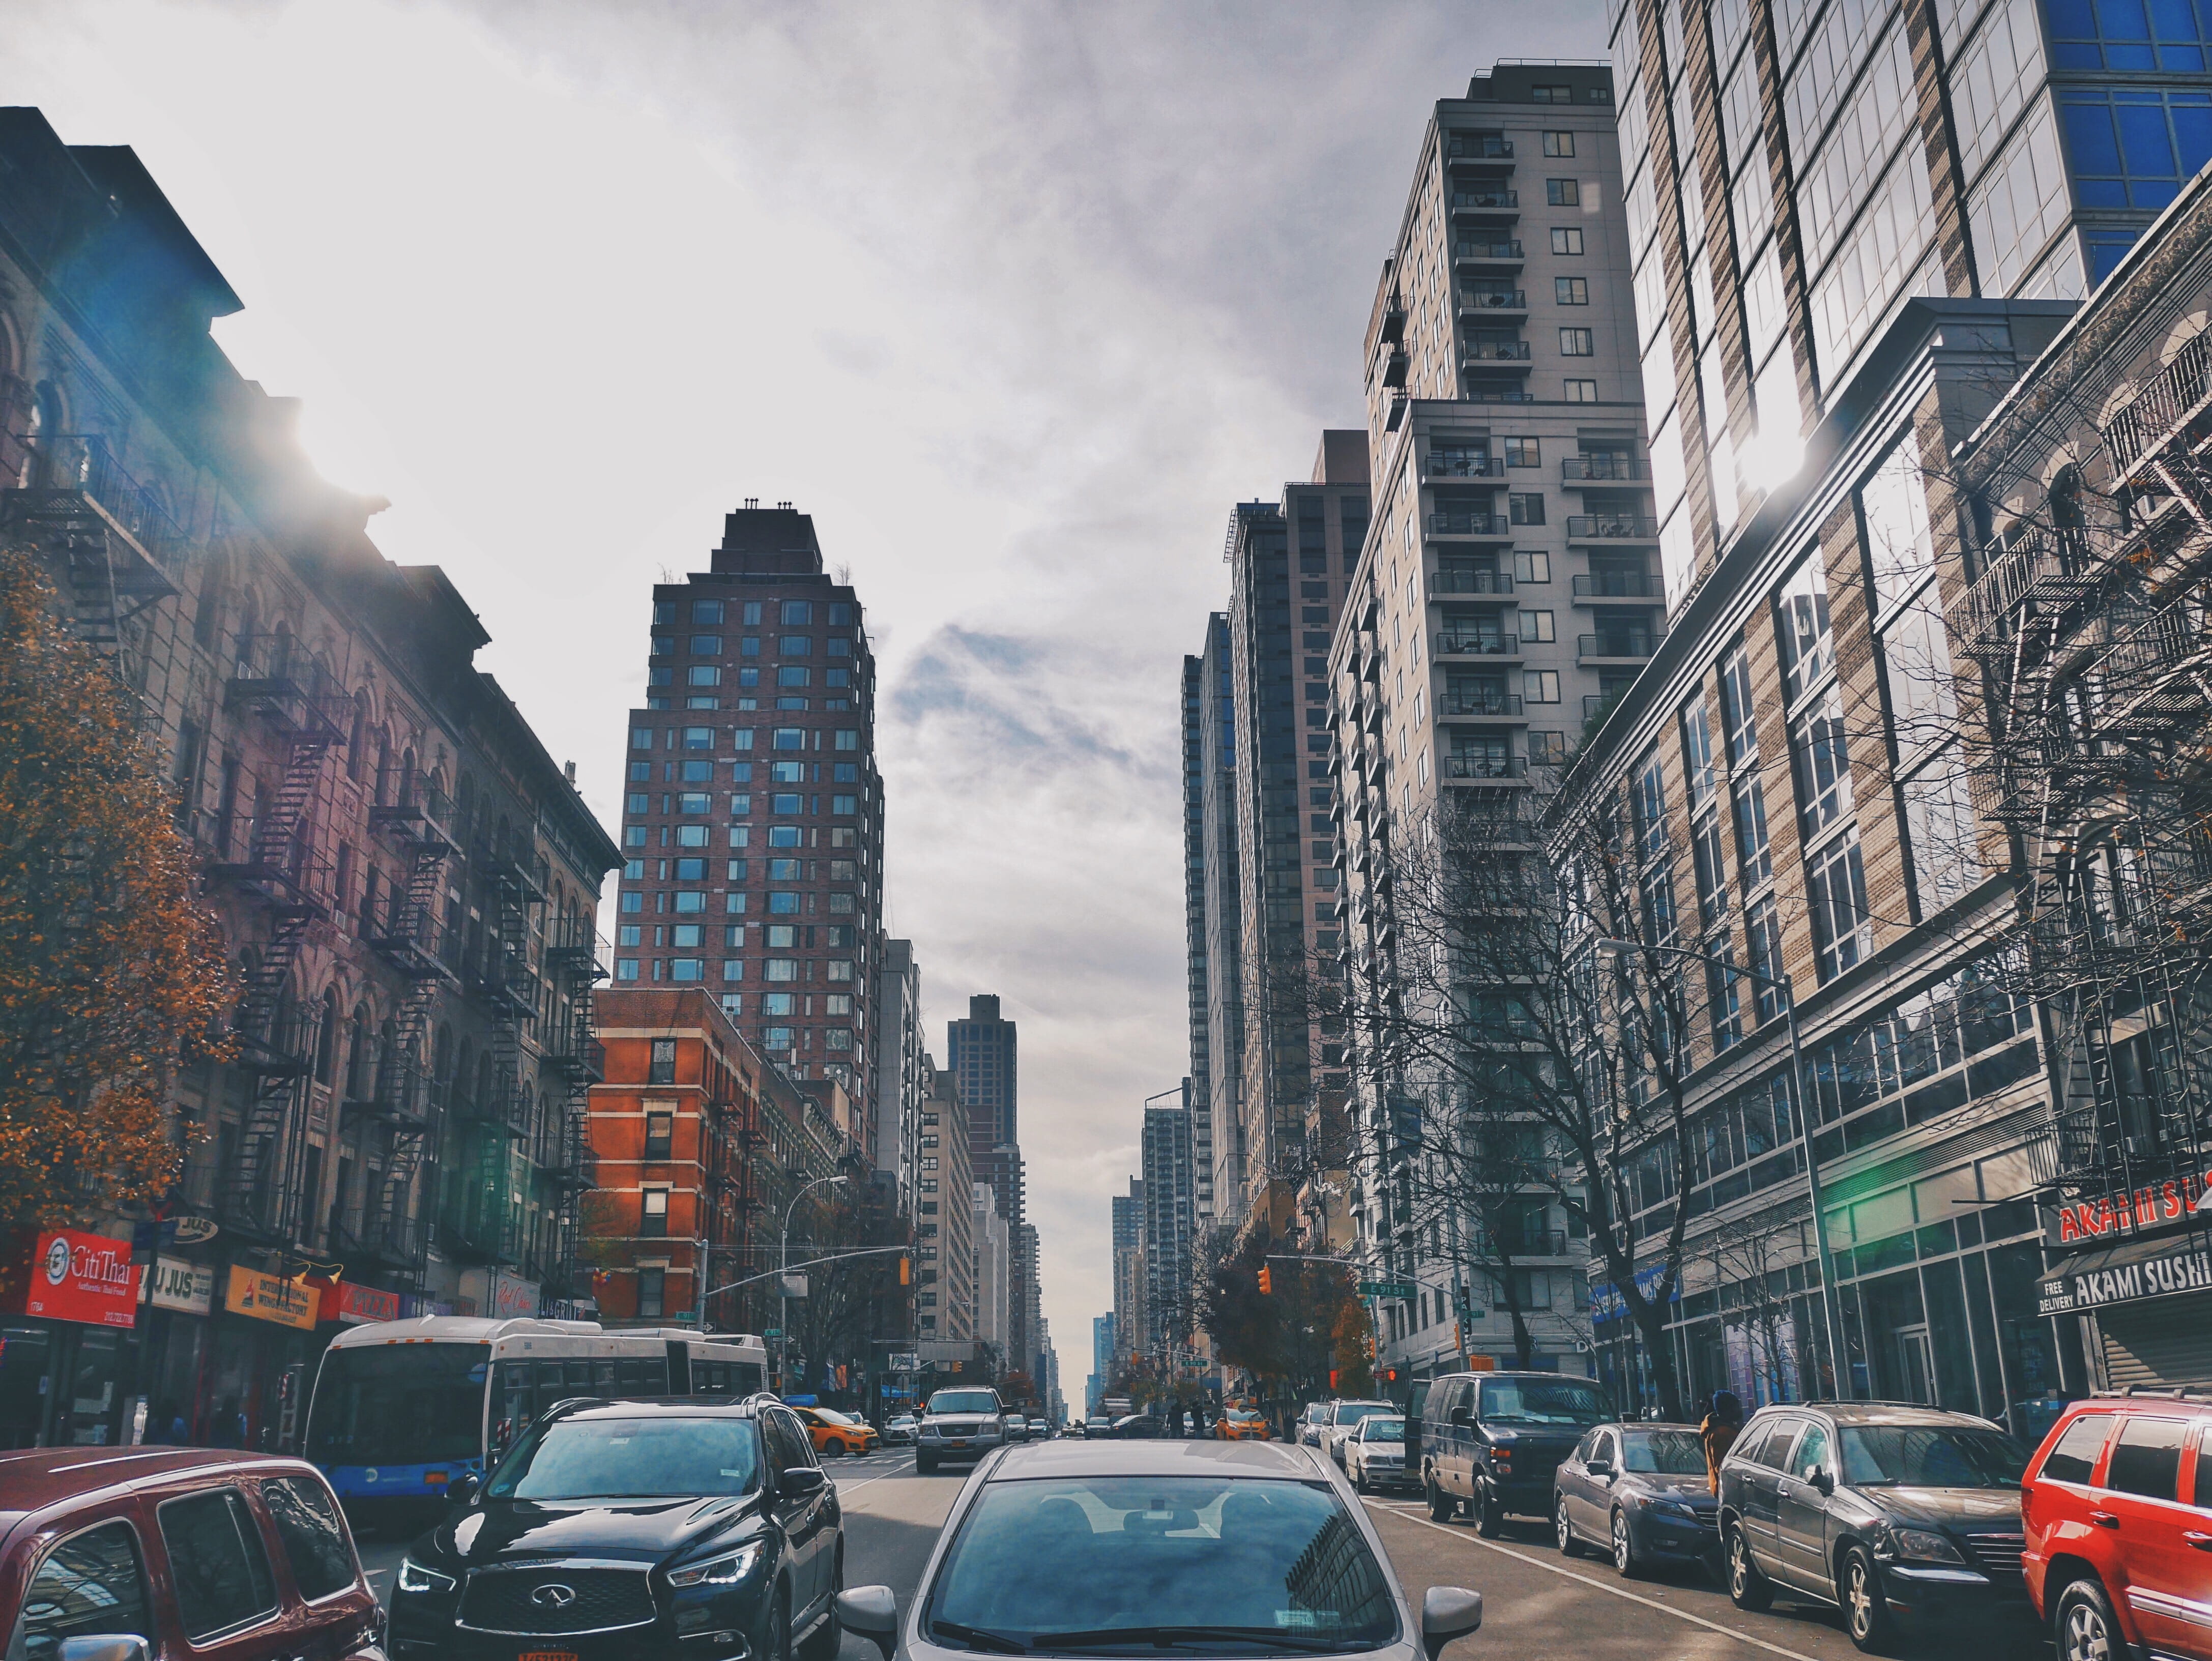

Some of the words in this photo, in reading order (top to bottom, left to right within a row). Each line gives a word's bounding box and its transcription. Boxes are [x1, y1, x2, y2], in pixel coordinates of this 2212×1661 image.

[2059, 1186, 2159, 1243] AKAMI
[2162, 1169, 2212, 1219] SU
[182, 1217, 212, 1233] JUS
[101, 1250, 131, 1285] Thai
[2075, 1265, 2143, 1305] AKAMI
[2145, 1251, 2212, 1294] SUSHI
[165, 1269, 193, 1299] JUS
[1380, 1286, 1390, 1294] 91
[1393, 1287, 1405, 1295] St
[2044, 1280, 2063, 1296] FREE
[353, 1290, 395, 1321] PIZZA
[2039, 1294, 2074, 1313] DELIVERY
